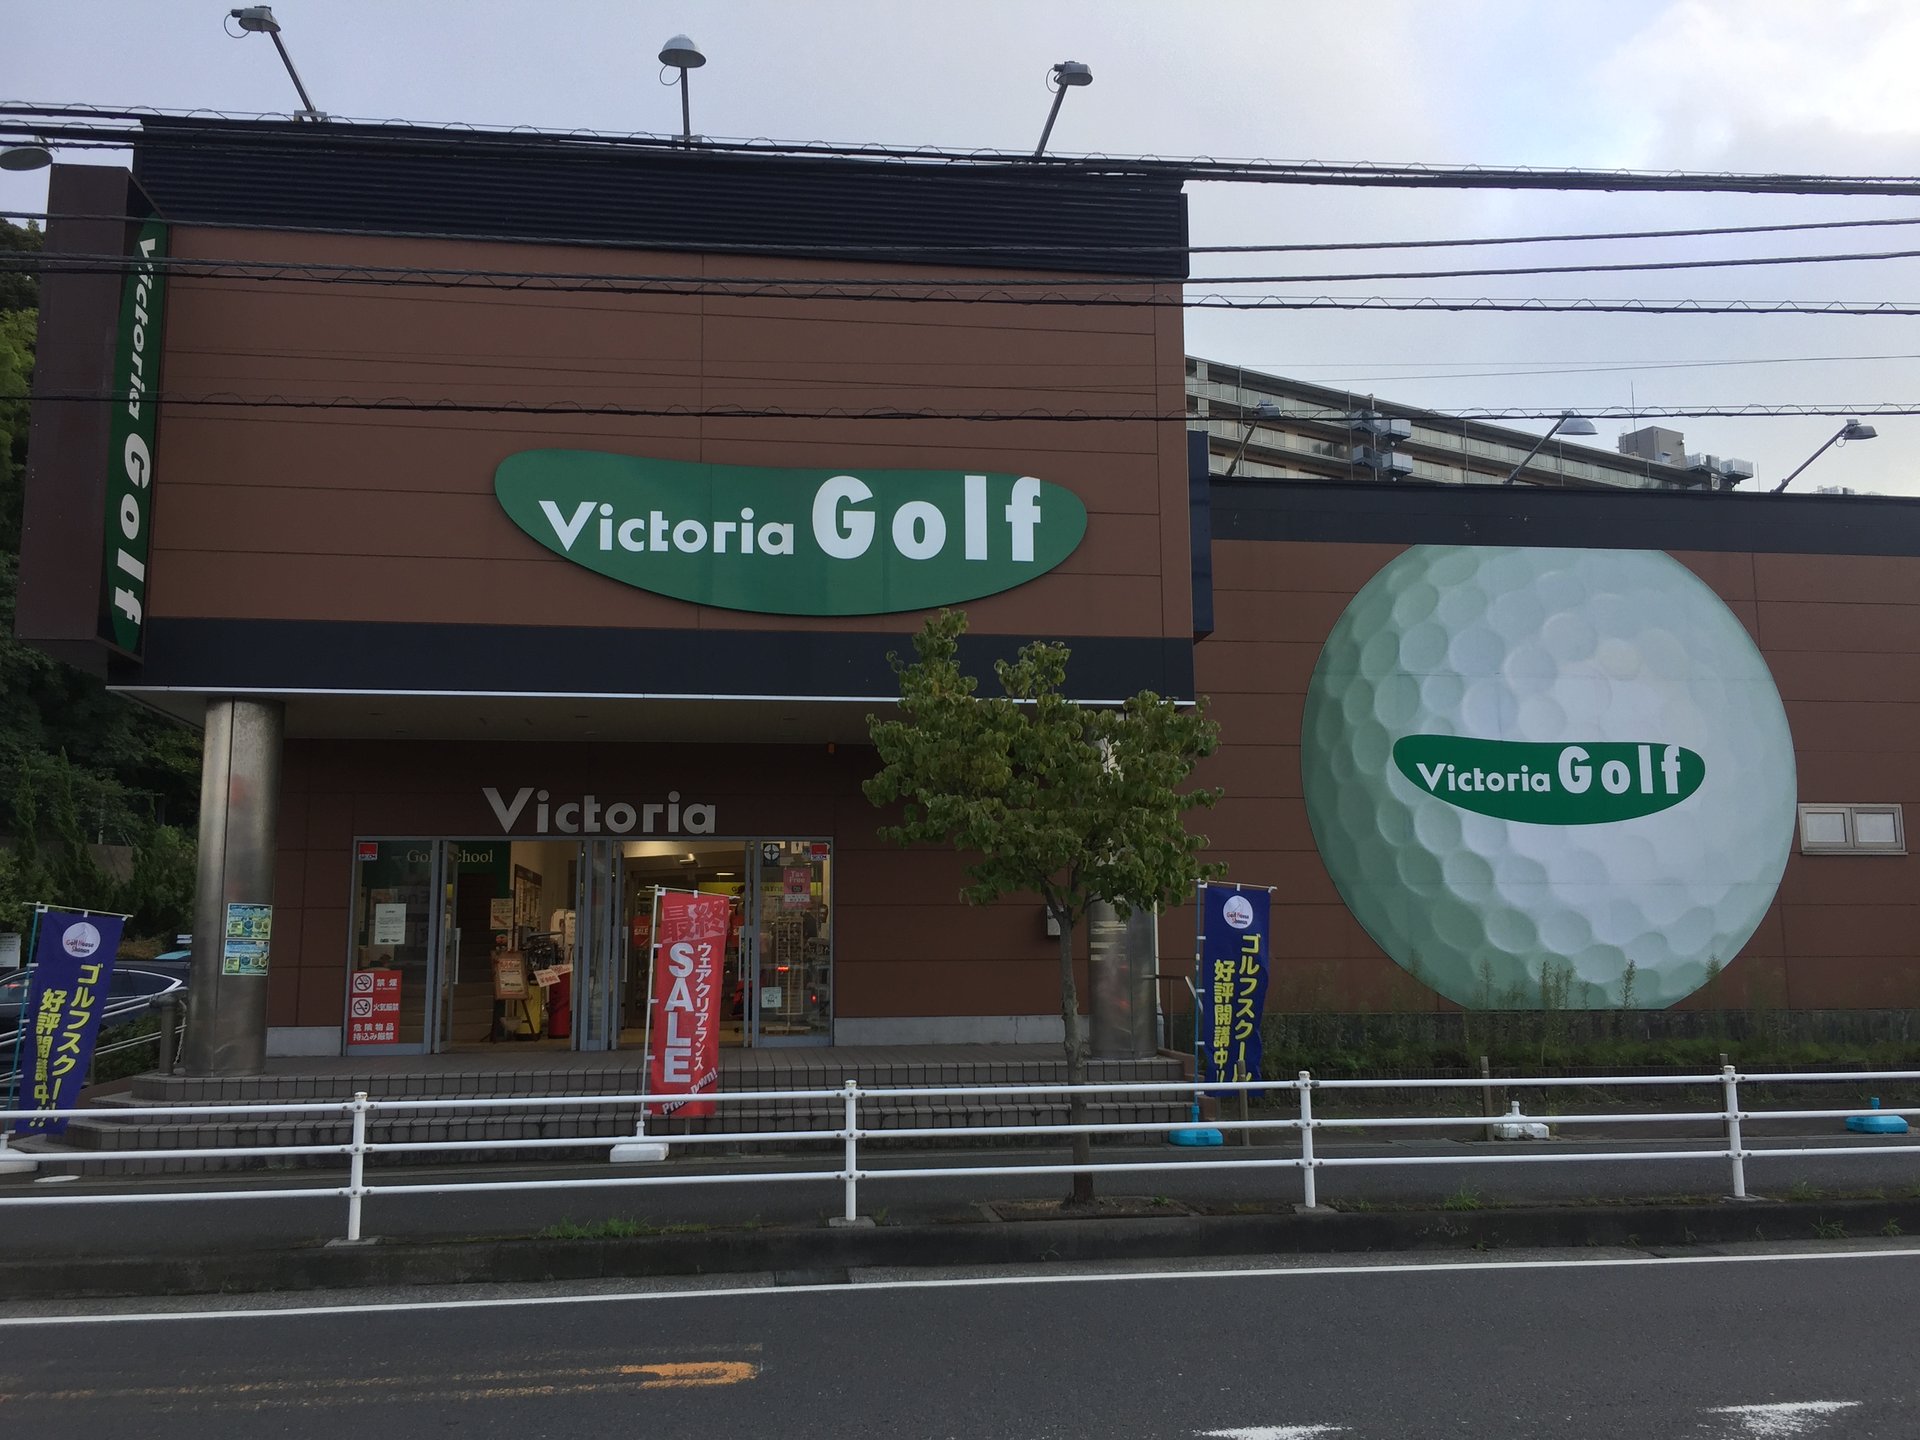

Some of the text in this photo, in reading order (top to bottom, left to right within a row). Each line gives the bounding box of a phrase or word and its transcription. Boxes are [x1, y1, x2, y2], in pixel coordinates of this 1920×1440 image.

[114, 237, 157, 626] Victoria Golf
[538, 475, 1042, 562] Victoria Golf
[1416, 744, 1681, 794] Victoria Golf
[482, 787, 716, 834] Victoria
[407, 849, 493, 863] Gol chool
[791, 869, 805, 878] Tax
[661, 899, 728, 944] 最終
[663, 942, 695, 1083] SALE
